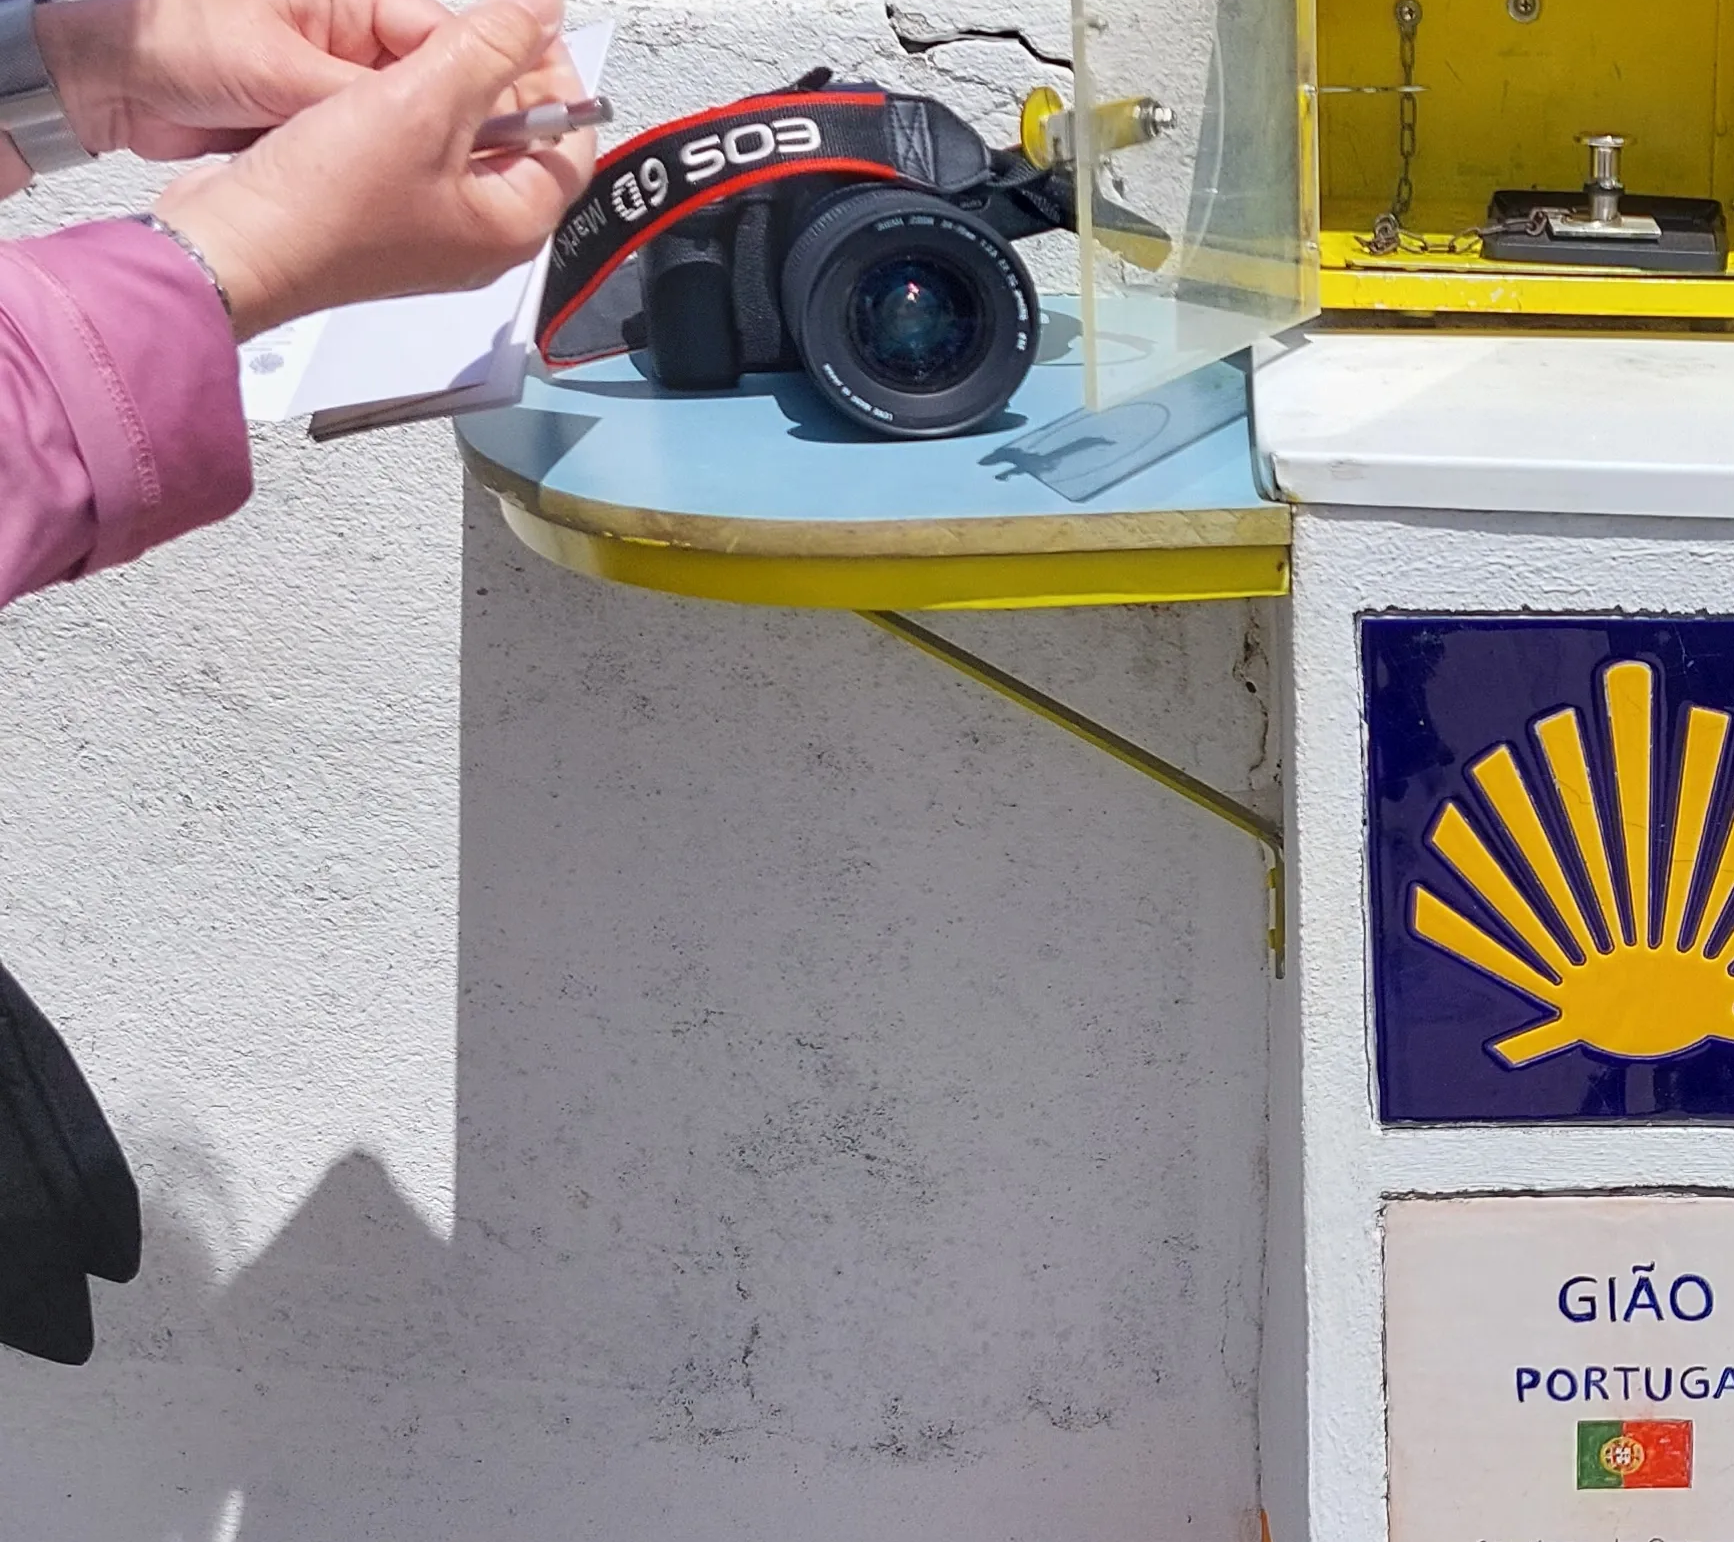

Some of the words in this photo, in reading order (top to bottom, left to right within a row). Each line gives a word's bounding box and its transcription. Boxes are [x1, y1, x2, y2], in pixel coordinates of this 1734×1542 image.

[680, 116, 822, 183] EOS
[611, 157, 669, 222] 6D
[556, 197, 608, 257] Mark
[1558, 1262, 1714, 1323] GIÃO
